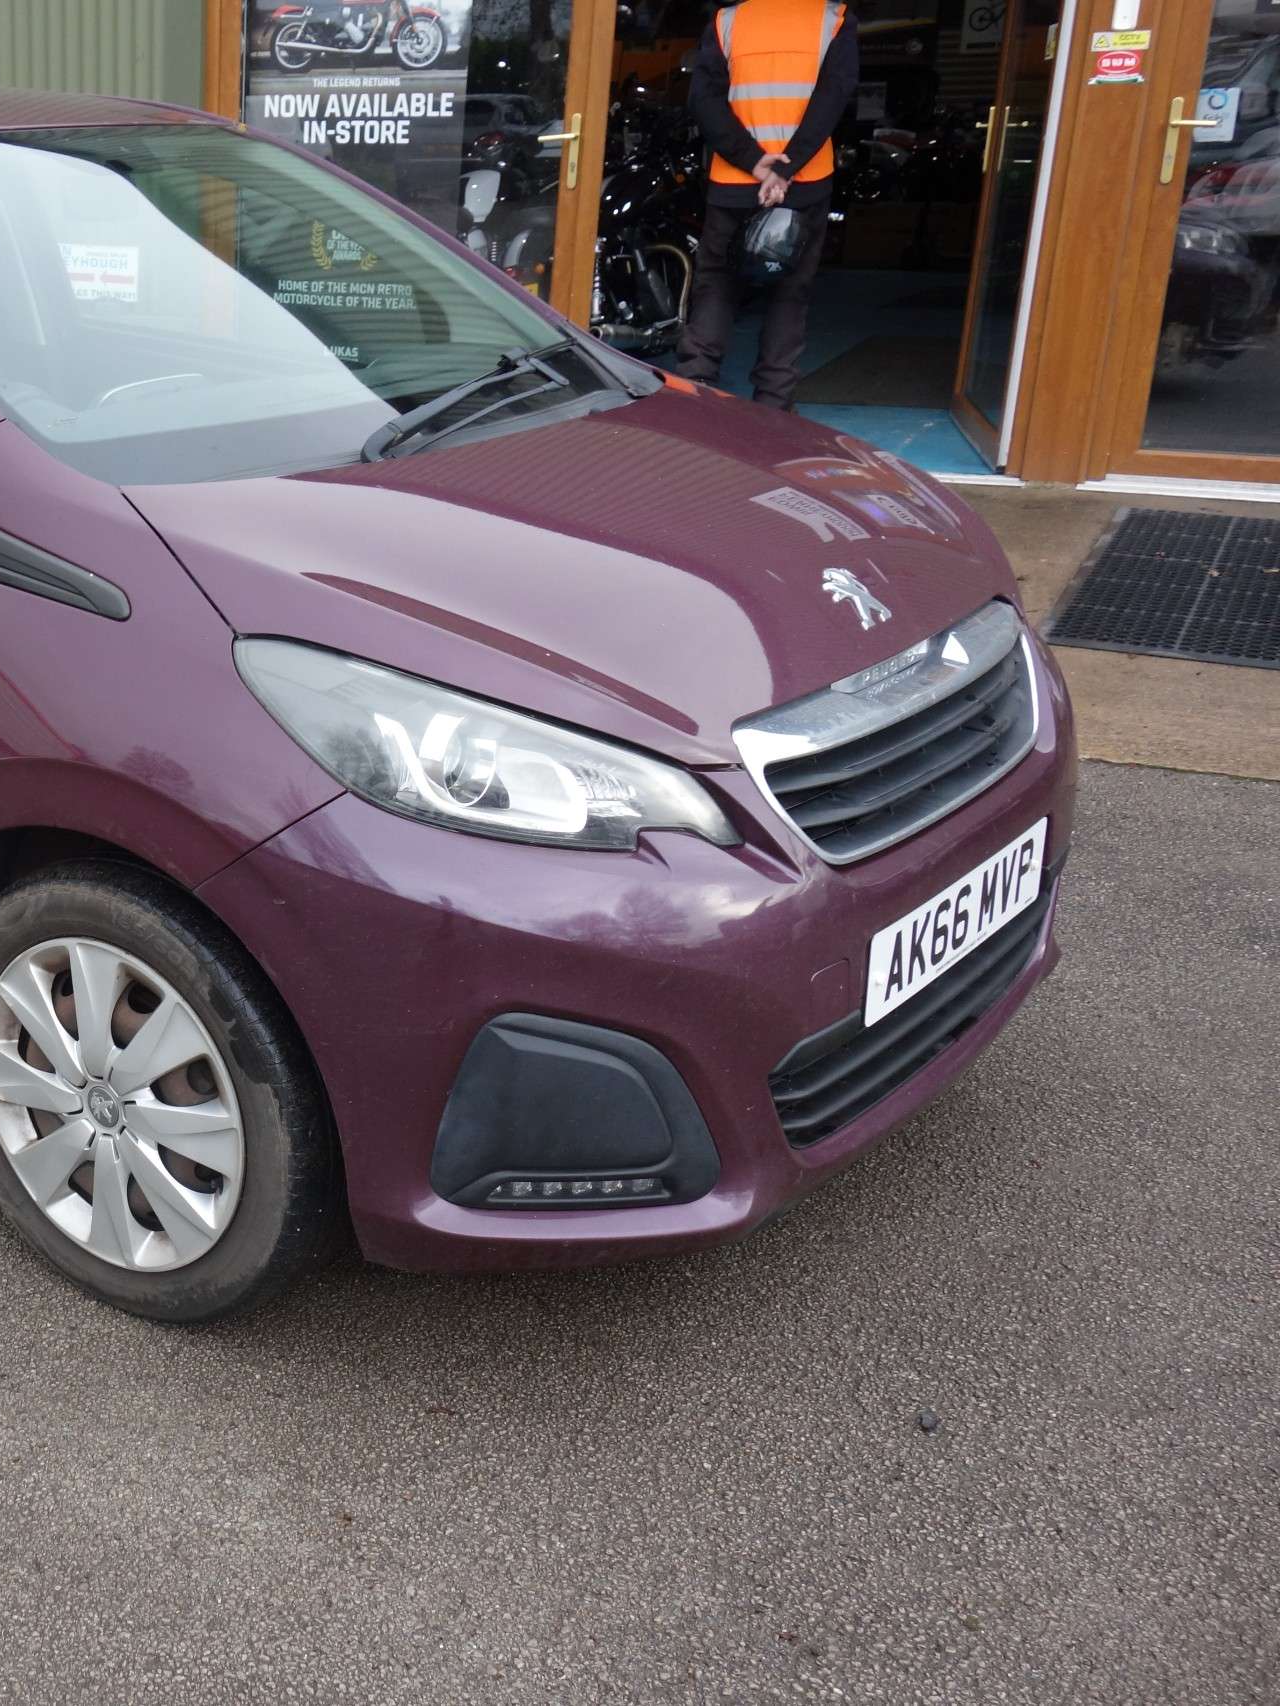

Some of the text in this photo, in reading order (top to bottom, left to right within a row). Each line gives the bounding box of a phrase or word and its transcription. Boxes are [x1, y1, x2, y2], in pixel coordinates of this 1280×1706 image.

[313, 77, 401, 88] THE LEGEND RETURNS
[264, 92, 455, 118] NOW AVAILABLE
[303, 120, 411, 144] IN-STORE
[337, 240, 348, 250] THE
[278, 280, 412, 296] HOME OF THE MCN RETRO
[273, 293, 416, 310] MOTORCYCLE OF THE YEAR.
[885, 883, 971, 1001] AK66
[977, 838, 1034, 933] MVP
